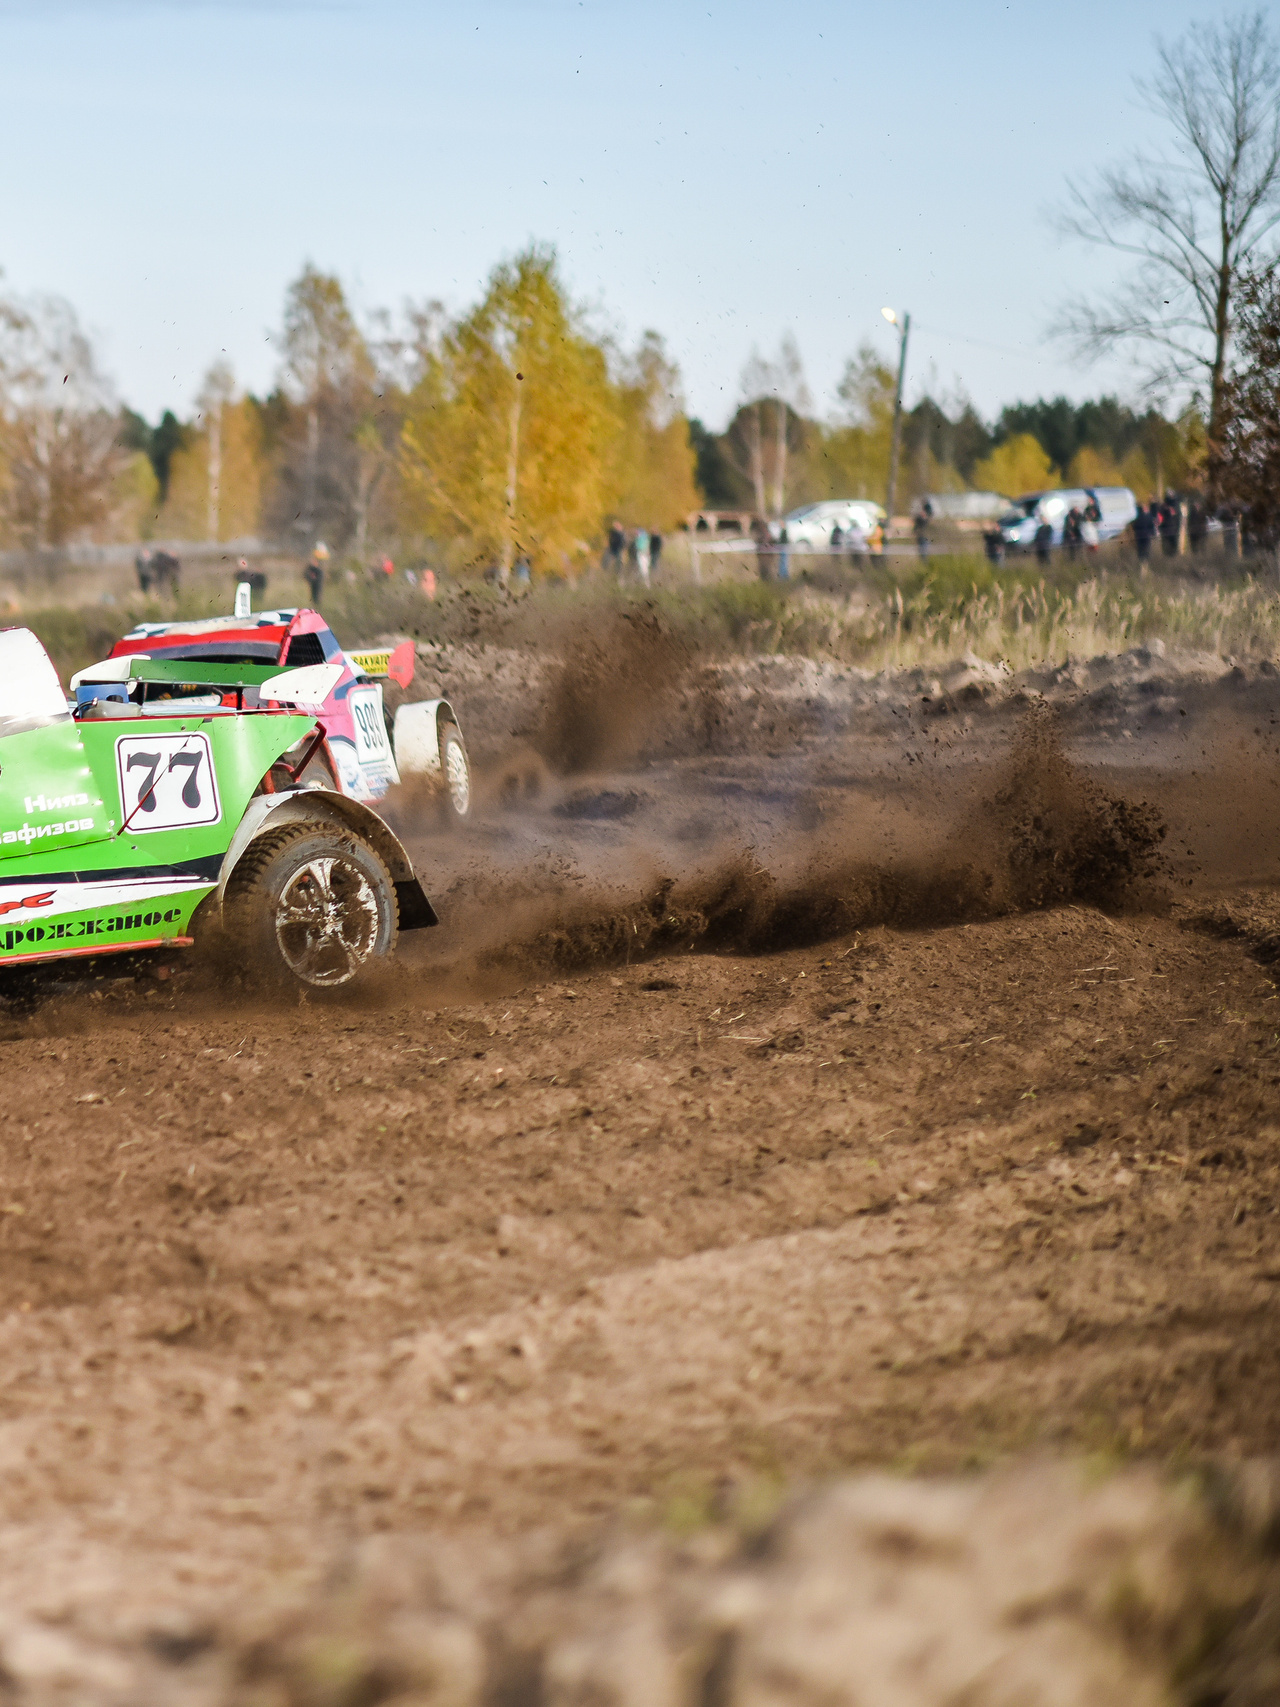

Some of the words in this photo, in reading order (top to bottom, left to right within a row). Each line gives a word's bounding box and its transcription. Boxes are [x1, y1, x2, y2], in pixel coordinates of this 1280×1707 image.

[354, 702, 384, 749] 999
[23, 793, 89, 814] Нияз
[126, 750, 203, 812] 77
